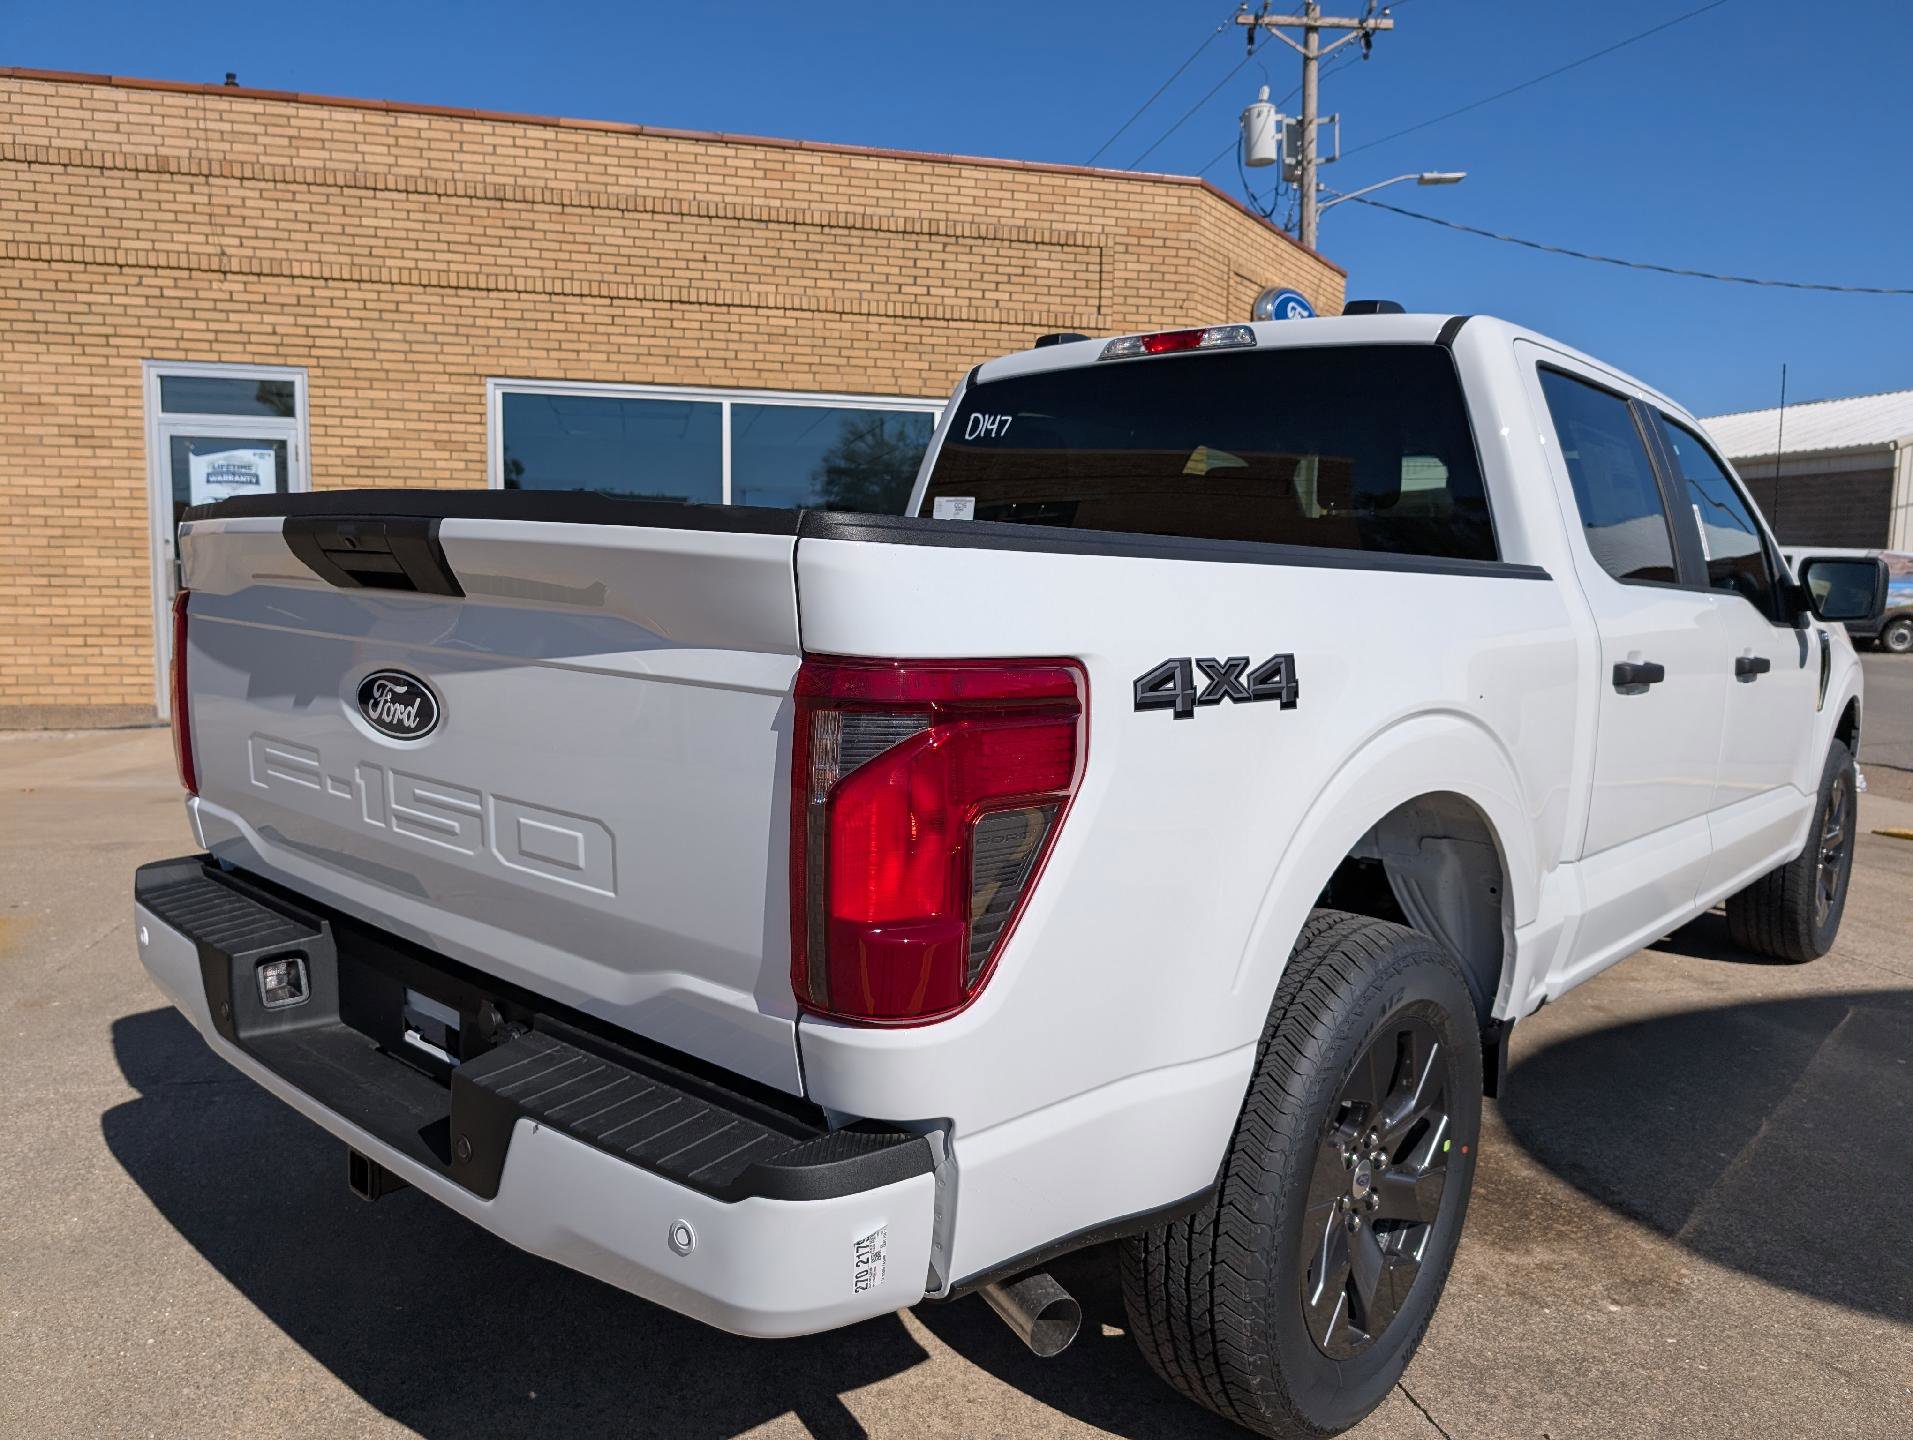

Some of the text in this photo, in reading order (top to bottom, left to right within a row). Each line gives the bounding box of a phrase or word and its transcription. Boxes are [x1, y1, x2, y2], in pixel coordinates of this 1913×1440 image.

[965, 412, 1012, 440] D147
[209, 474, 257, 483] WARRANTY
[212, 463, 255, 471] LIFETIME
[367, 678, 421, 730] Ford
[248, 730, 619, 898] F-150
[854, 1269, 869, 1293] 270
